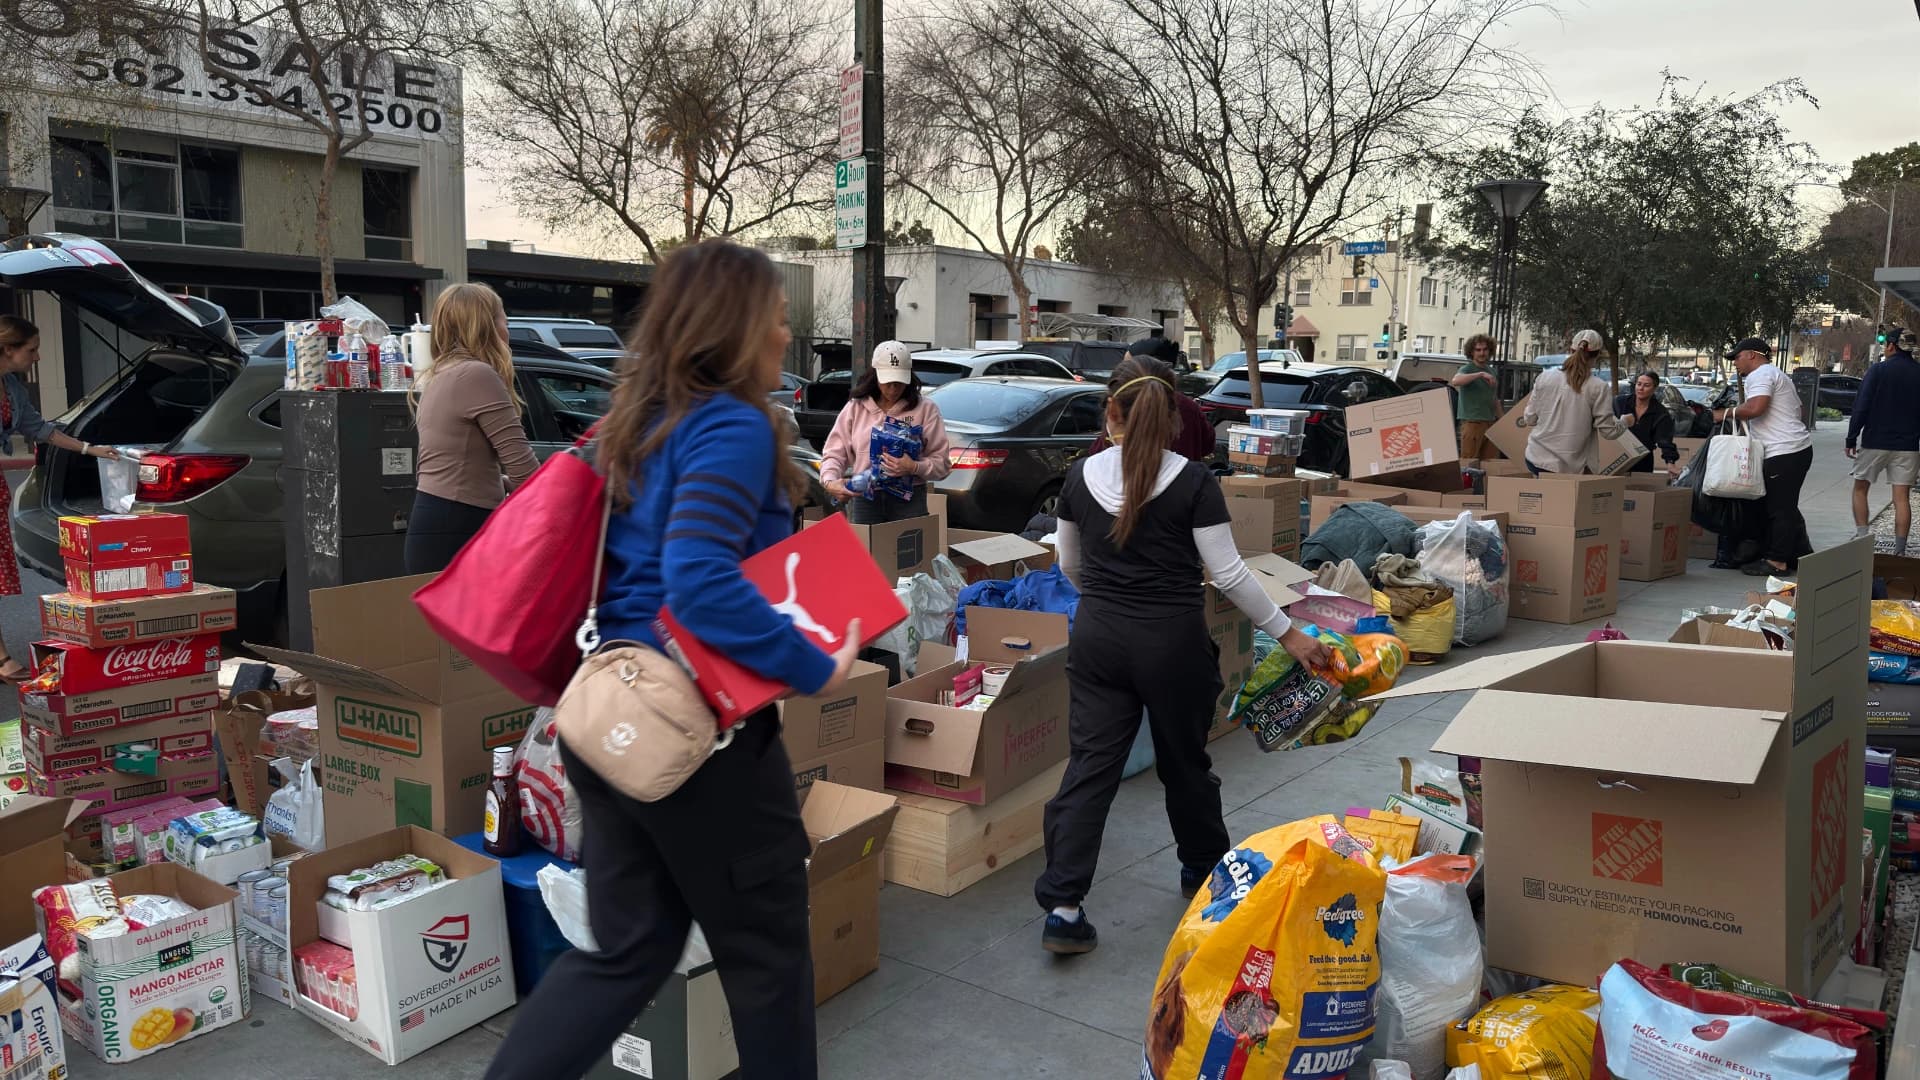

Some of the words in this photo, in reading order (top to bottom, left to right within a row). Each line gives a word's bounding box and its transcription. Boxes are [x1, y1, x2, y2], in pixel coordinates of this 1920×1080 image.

[206, 28, 438, 103] SALE
[838, 166, 846, 185] 2
[849, 166, 865, 183] HOUR
[837, 190, 865, 210] PARKING
[122, 672, 154, 681] ORIGINAL
[158, 668, 177, 676] TASTE
[1311, 684, 1325, 701] 57
[72, 717, 114, 731] Ramen
[341, 704, 416, 739] U-HAUL
[488, 713, 536, 737] U-HA
[53, 756, 96, 770] Ramen
[325, 754, 357, 775] LARGE
[360, 766, 381, 782] BOX
[460, 773, 488, 790] NEED
[795, 768, 824, 787] ARGE
[346, 787, 354, 797] FT
[1358, 836, 1375, 849] eow
[1599, 822, 1628, 846] THE
[1593, 819, 1663, 878] HOME
[1619, 844, 1663, 882] DEPOT
[1315, 906, 1365, 925] Pedigree
[1548, 881, 1592, 898] QUICKLY
[1594, 889, 1647, 907] ESTIMATE
[1649, 897, 1681, 914] YOUR
[1683, 903, 1735, 922] PACKING
[1548, 892, 1588, 909] SUPPLY
[1590, 900, 1626, 915] NEEDS
[1628, 906, 1643, 917] AT
[1643, 909, 1743, 935] HDMOVING.COM
[136, 927, 173, 946] GALLON
[175, 917, 209, 933] BOTTLE
[160, 945, 191, 963] LANGERS
[1309, 955, 1323, 964] Feed
[1323, 954, 1335, 963] the
[129, 975, 176, 999] MANGO
[177, 957, 225, 982] NECTAR
[240, 960, 250, 1011] ORGANIC
[398, 976, 456, 1010] SOVEREIGN
[458, 955, 501, 982] AMERICA
[1255, 954, 1275, 989] VALUE
[429, 992, 464, 1018] MADE
[465, 986, 477, 1001] IN
[480, 975, 503, 992] USA
[31, 1006, 55, 1057] Ensure
[97, 985, 121, 1058] ORGANIC
[1291, 1044, 1364, 1075] ADULT
[1632, 1023, 1670, 1048] nature.
[1672, 1042, 1724, 1066] RESEARCH.
[1725, 1060, 1772, 1080] RESULTS
